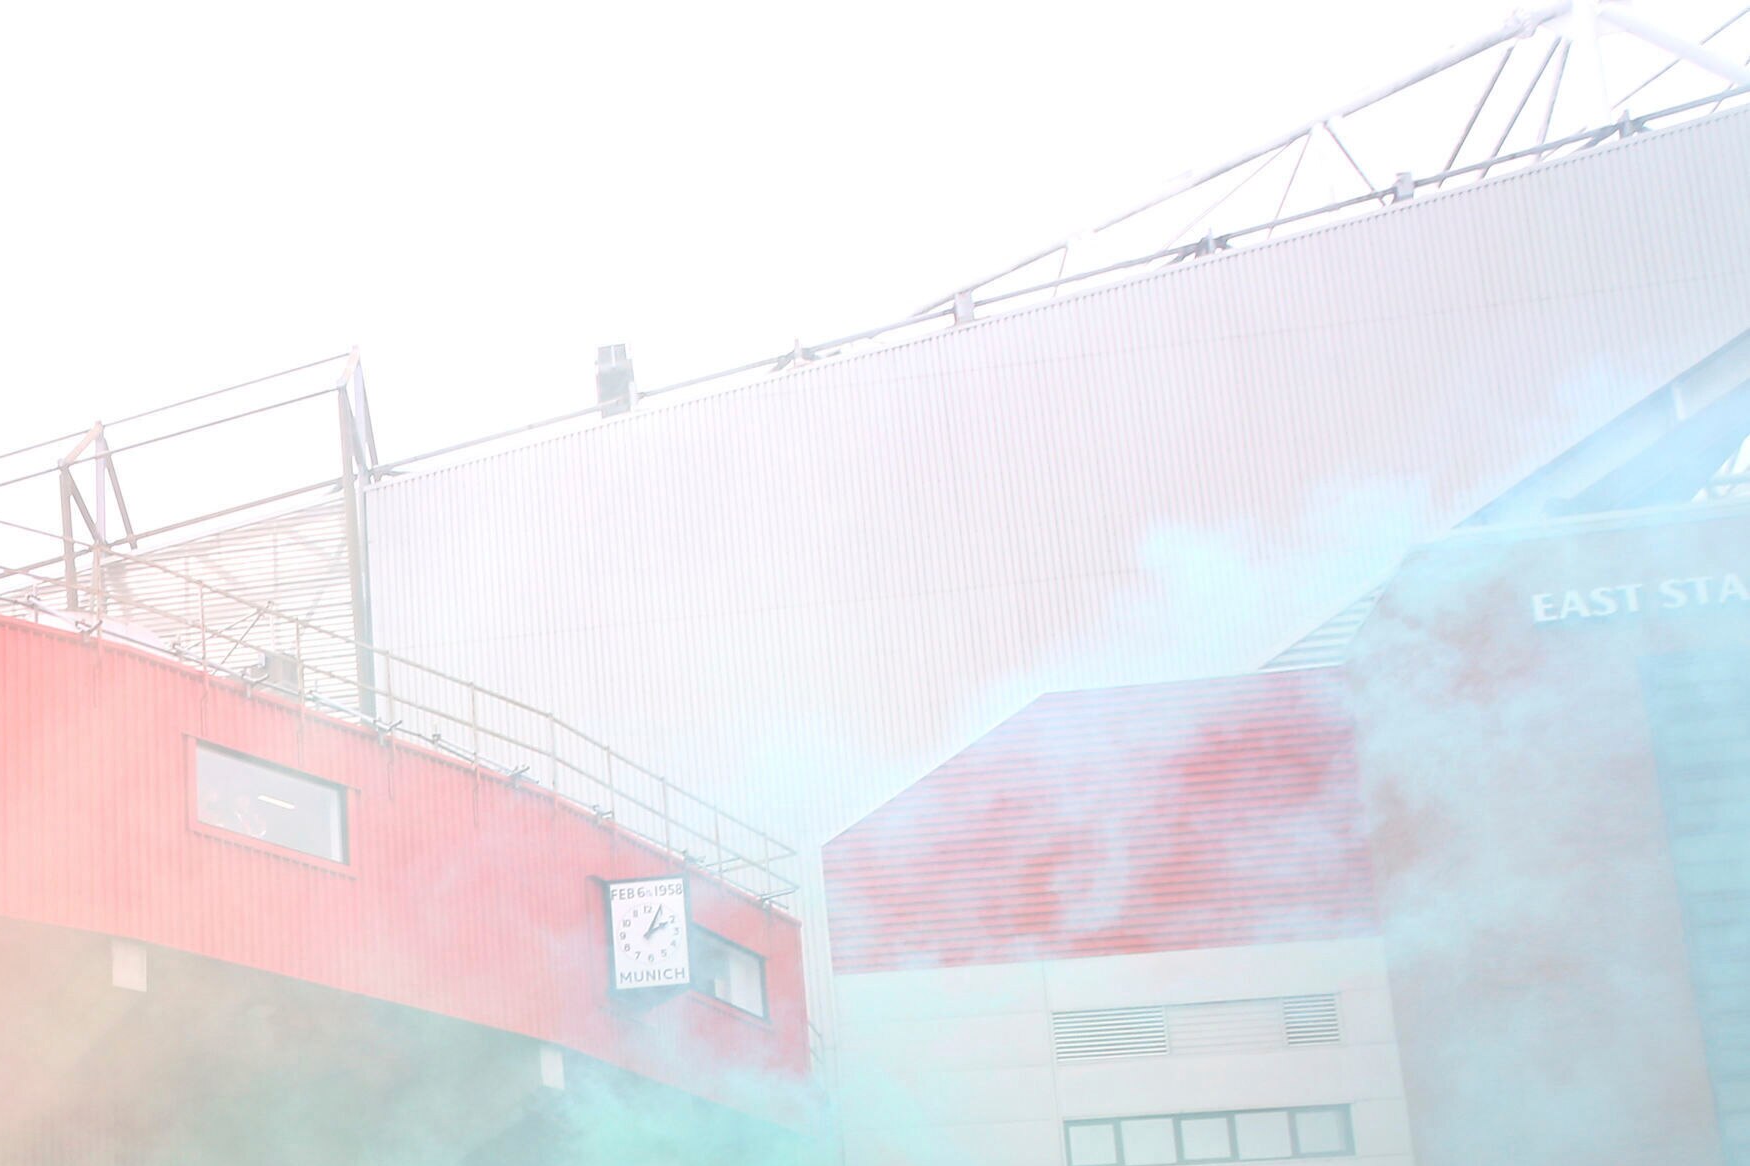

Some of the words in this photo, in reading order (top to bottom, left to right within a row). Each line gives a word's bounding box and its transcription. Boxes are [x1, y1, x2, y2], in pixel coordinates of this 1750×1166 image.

[1531, 582, 1643, 623] EAST
[1658, 572, 1750, 610] STA
[611, 888, 635, 901] FEB
[654, 883, 683, 896] 1958
[620, 968, 685, 983] MUNICH
